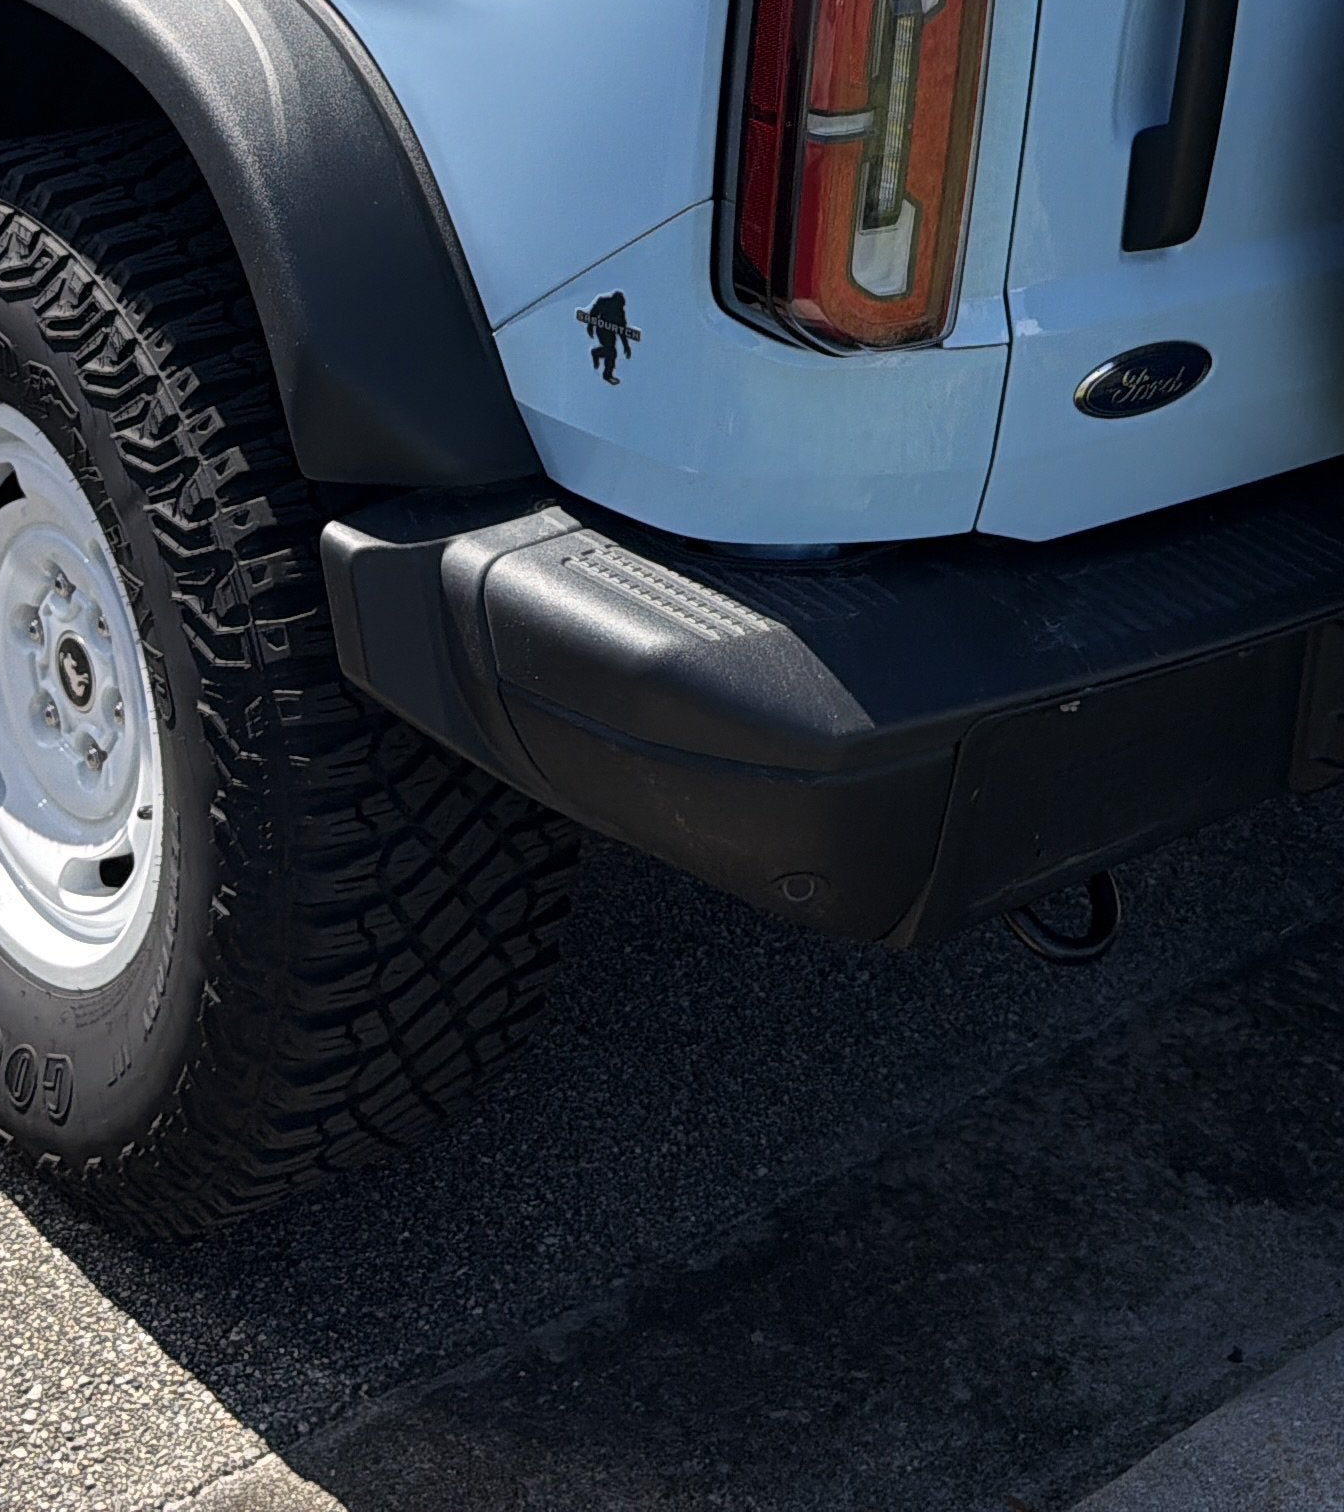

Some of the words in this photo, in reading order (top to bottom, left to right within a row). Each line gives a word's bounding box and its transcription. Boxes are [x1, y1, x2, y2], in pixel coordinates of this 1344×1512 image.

[577, 311, 641, 340] SASQUATCH
[1111, 364, 1187, 404] Ford
[142, 806, 181, 1042] TERRITORY
